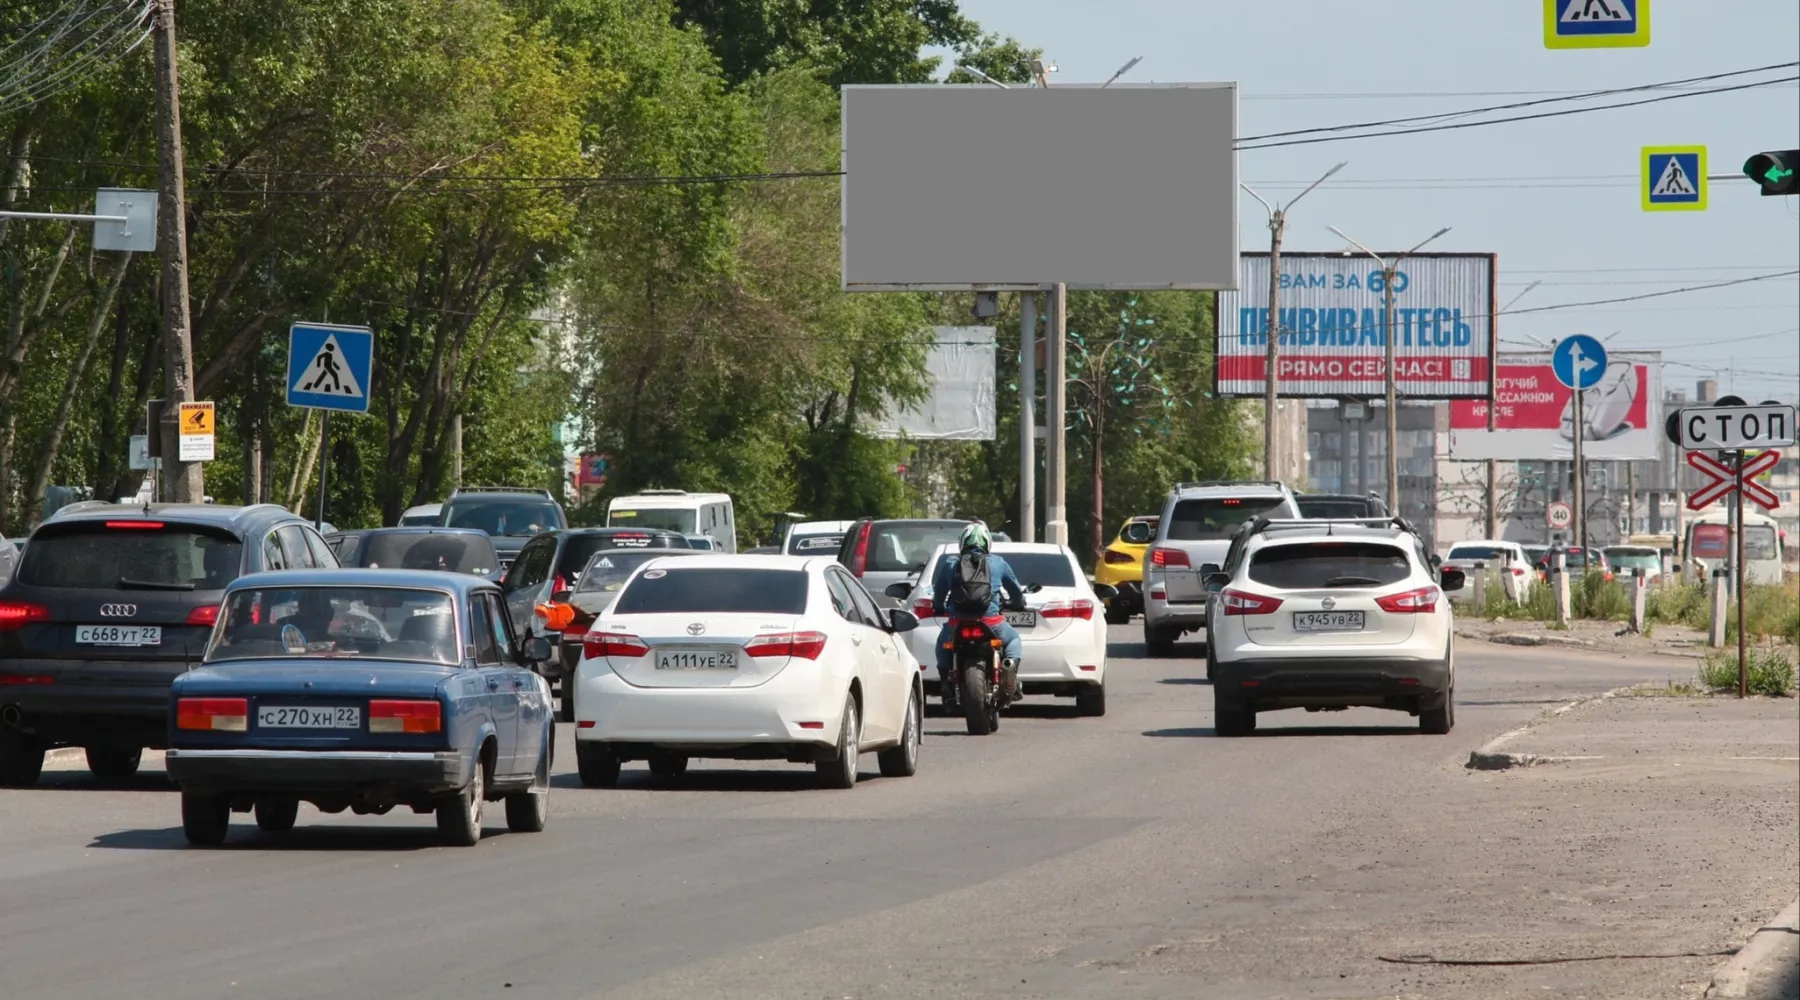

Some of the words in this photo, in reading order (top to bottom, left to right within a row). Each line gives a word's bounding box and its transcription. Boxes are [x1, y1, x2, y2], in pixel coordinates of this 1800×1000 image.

[1279, 273, 1326, 289] ВАМ
[1332, 273, 1362, 289] ЗА
[1367, 270, 1409, 293] 60
[1239, 297, 1471, 347] ПРИВИВАЙТЕСЬ
[1264, 360, 1343, 376] РЯМО
[1349, 357, 1443, 376] СЕЙЧАС!
[1472, 405, 1515, 417] КРСЛЕ
[1688, 413, 1785, 442] СТОП
[1553, 510, 1568, 521] 40
